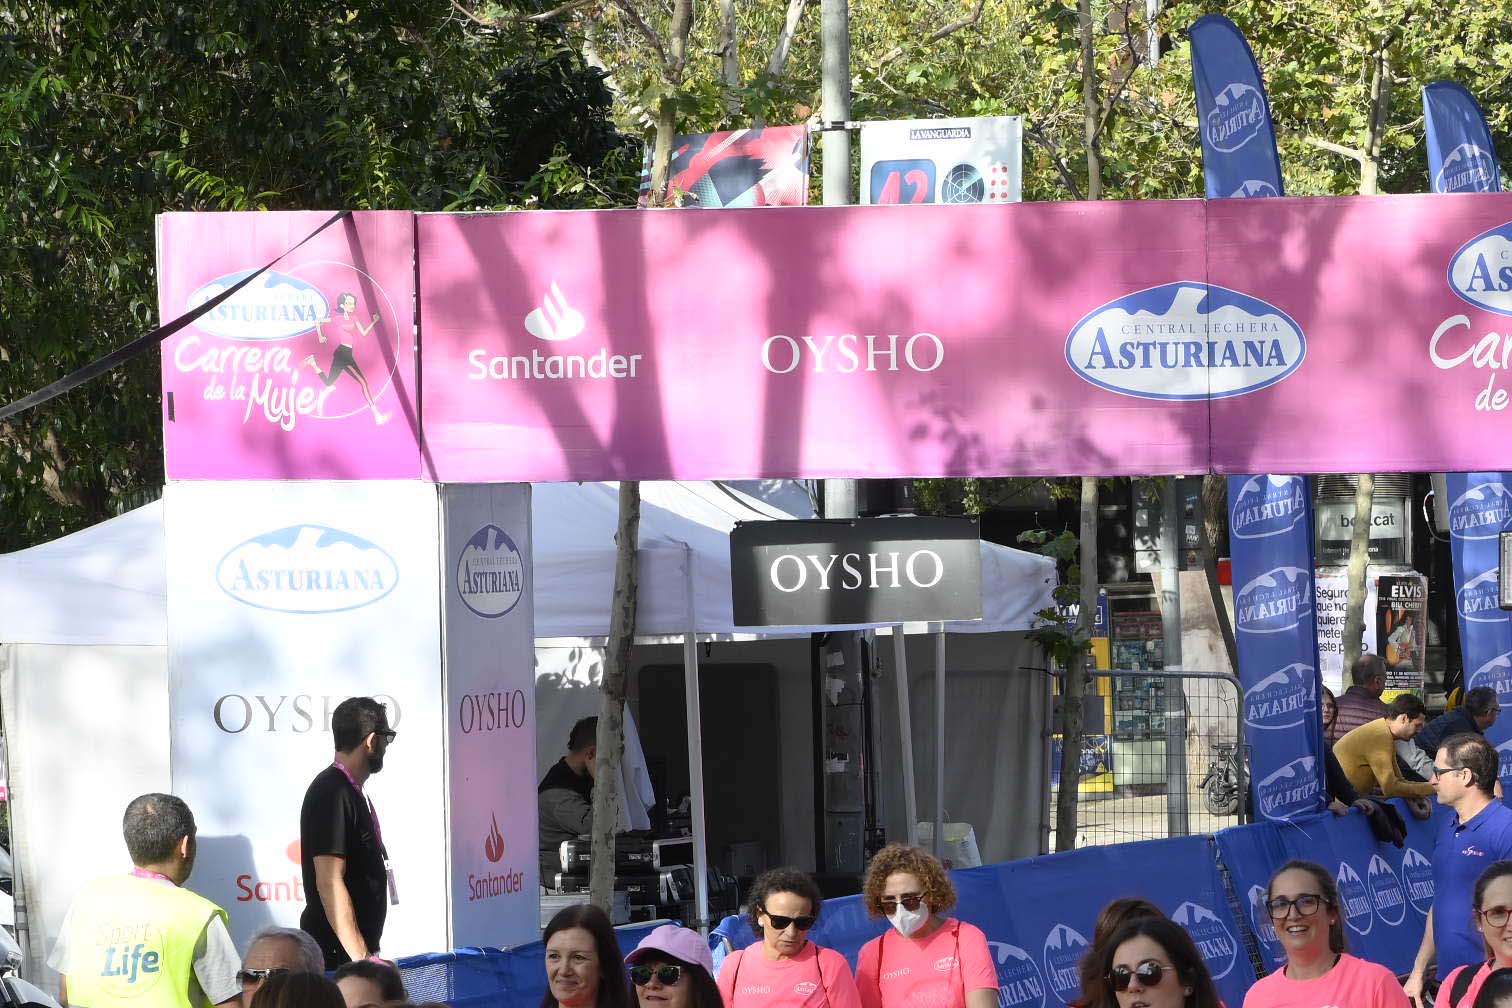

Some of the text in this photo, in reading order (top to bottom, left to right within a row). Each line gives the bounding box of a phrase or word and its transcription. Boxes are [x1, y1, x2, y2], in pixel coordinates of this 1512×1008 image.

[1120, 321, 1279, 335] CENTRAL LECHERA
[174, 335, 292, 373] Carrera
[469, 348, 642, 380] Santander
[761, 333, 944, 373] OYSHO
[1085, 327, 1287, 370] ASTURIANA
[203, 375, 247, 401] de la
[243, 368, 336, 431] Mujer
[1475, 373, 1509, 411] de
[231, 559, 384, 592] ASTURIANA
[463, 561, 520, 595] ASTURIANA
[770, 550, 944, 592] OYSHO
[1392, 585, 1422, 598] ELVIS
[459, 689, 526, 735] OYSHO
[468, 872, 524, 901] Santander
[101, 943, 160, 984] Life
